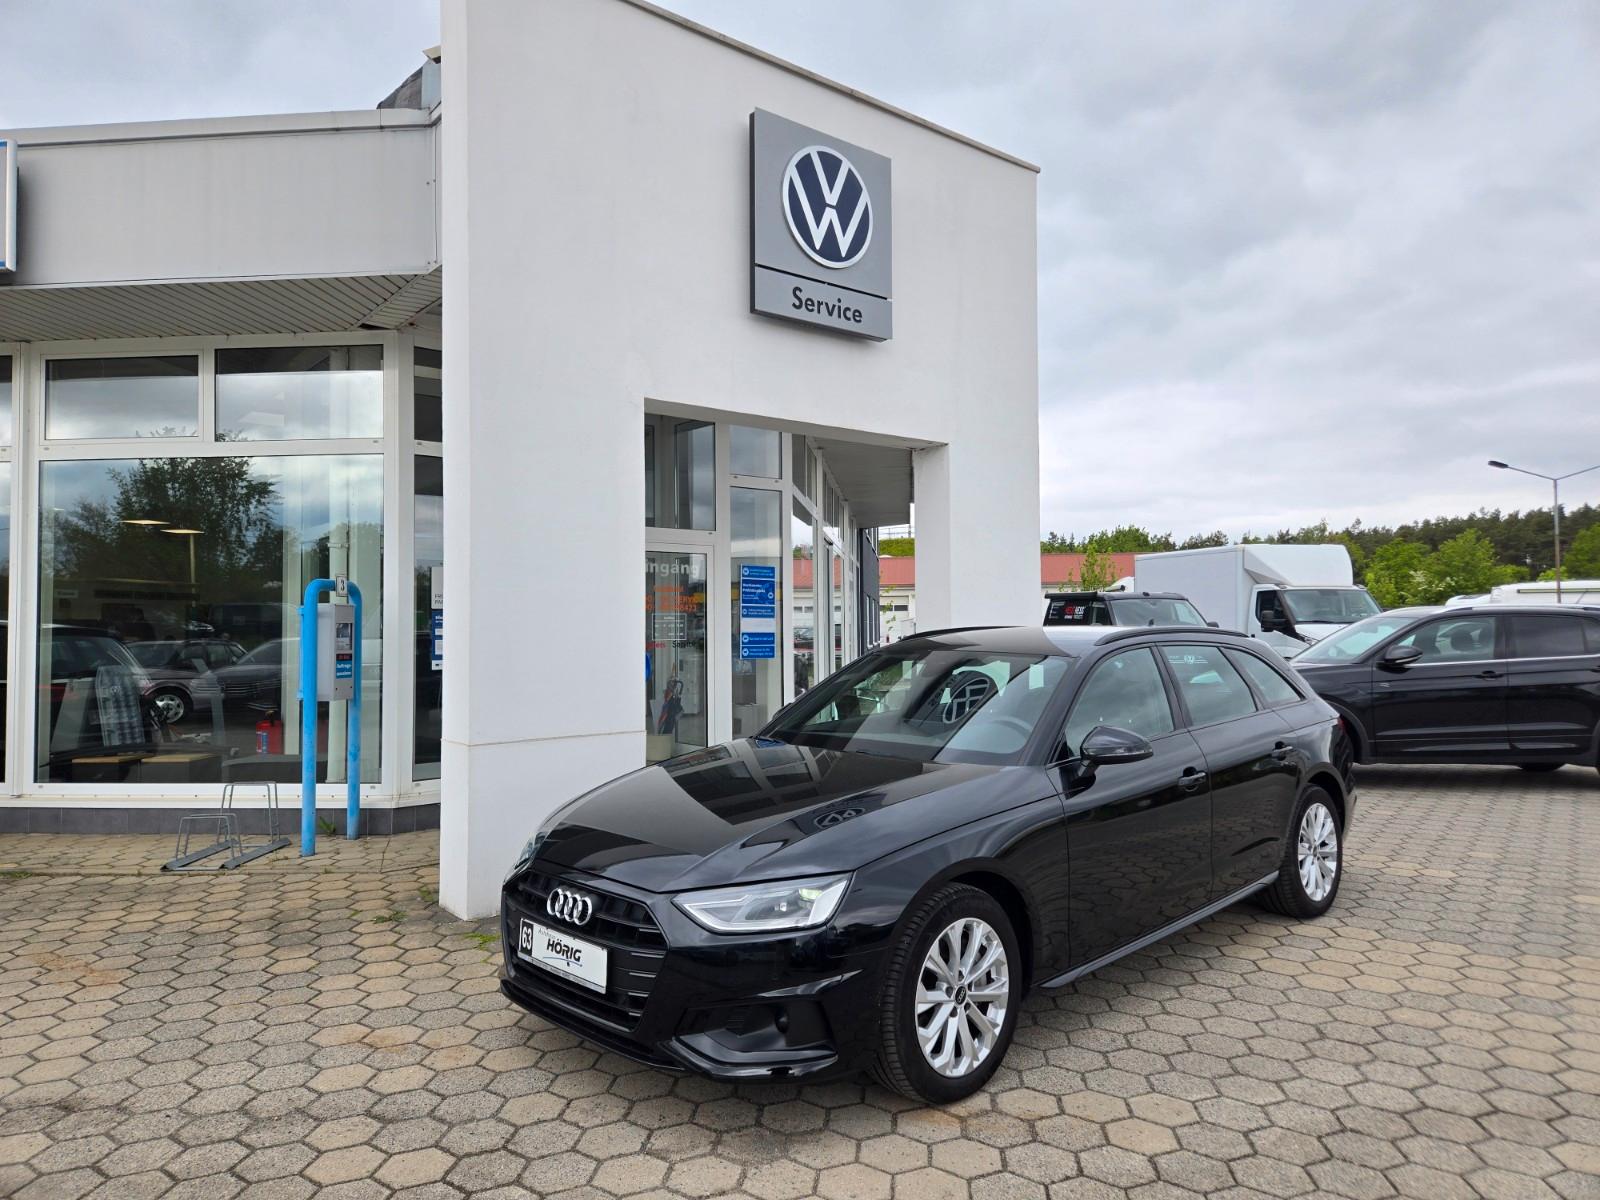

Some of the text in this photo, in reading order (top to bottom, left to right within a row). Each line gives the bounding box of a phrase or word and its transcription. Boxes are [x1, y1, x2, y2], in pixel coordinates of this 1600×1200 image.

[792, 286, 863, 323] Service
[645, 561, 699, 578] ingang
[340, 579, 345, 592] 3
[522, 926, 532, 950] 63
[546, 938, 582, 963] HÖRIG
